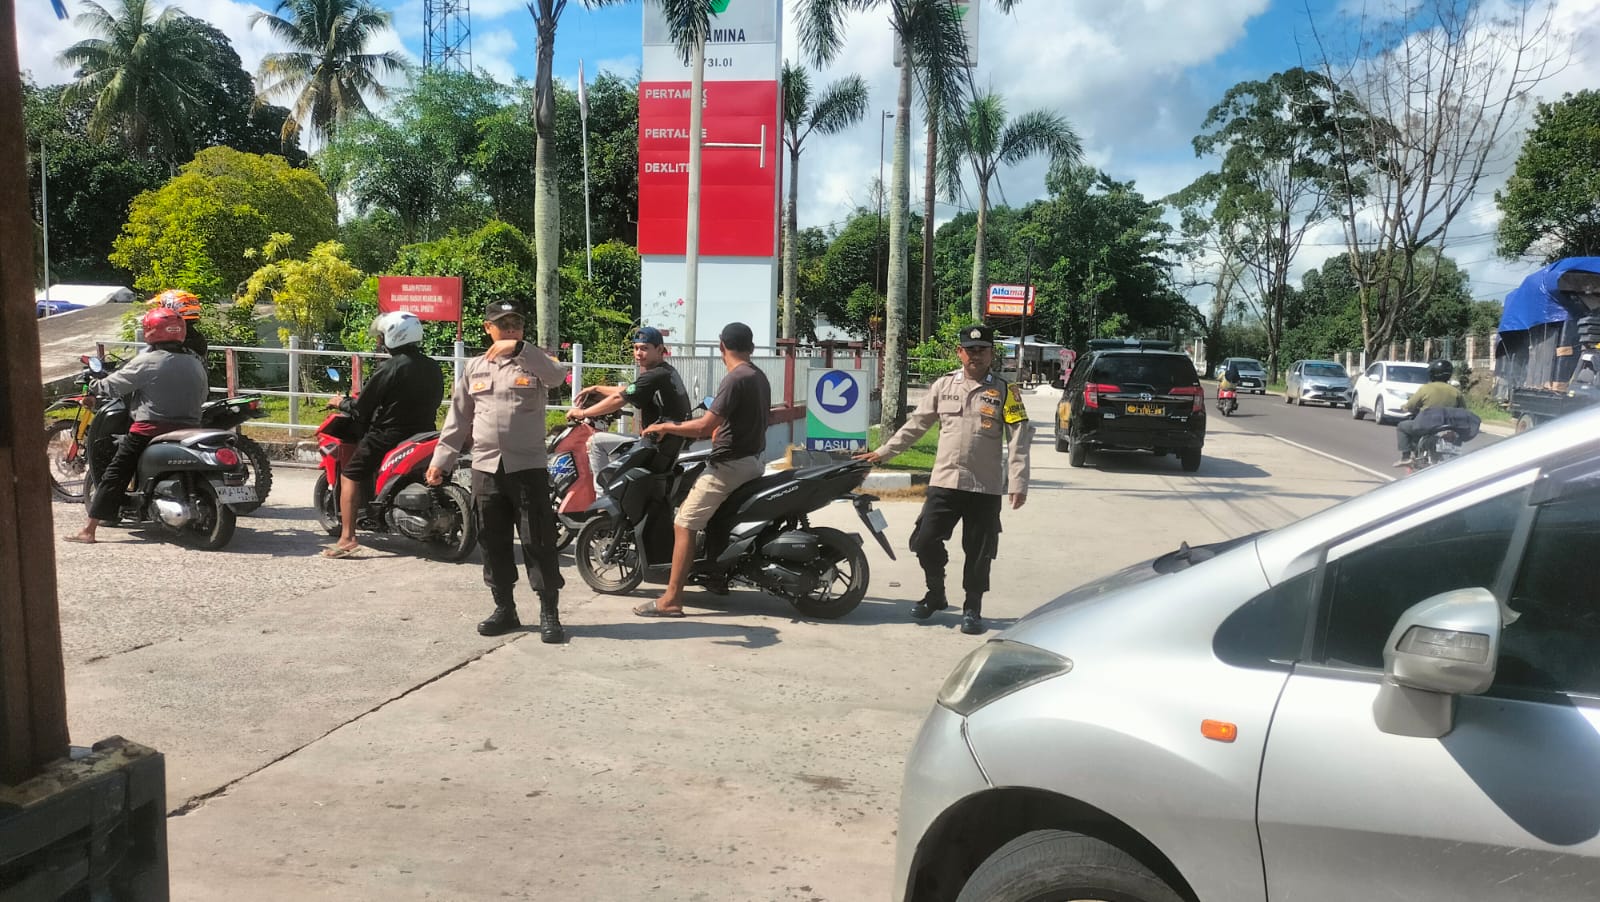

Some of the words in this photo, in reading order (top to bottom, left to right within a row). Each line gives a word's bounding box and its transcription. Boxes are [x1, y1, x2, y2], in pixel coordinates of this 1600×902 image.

[671, 28, 746, 43] PAMINA
[645, 128, 707, 138] PERTALE
[992, 287, 1026, 296] Alfama
